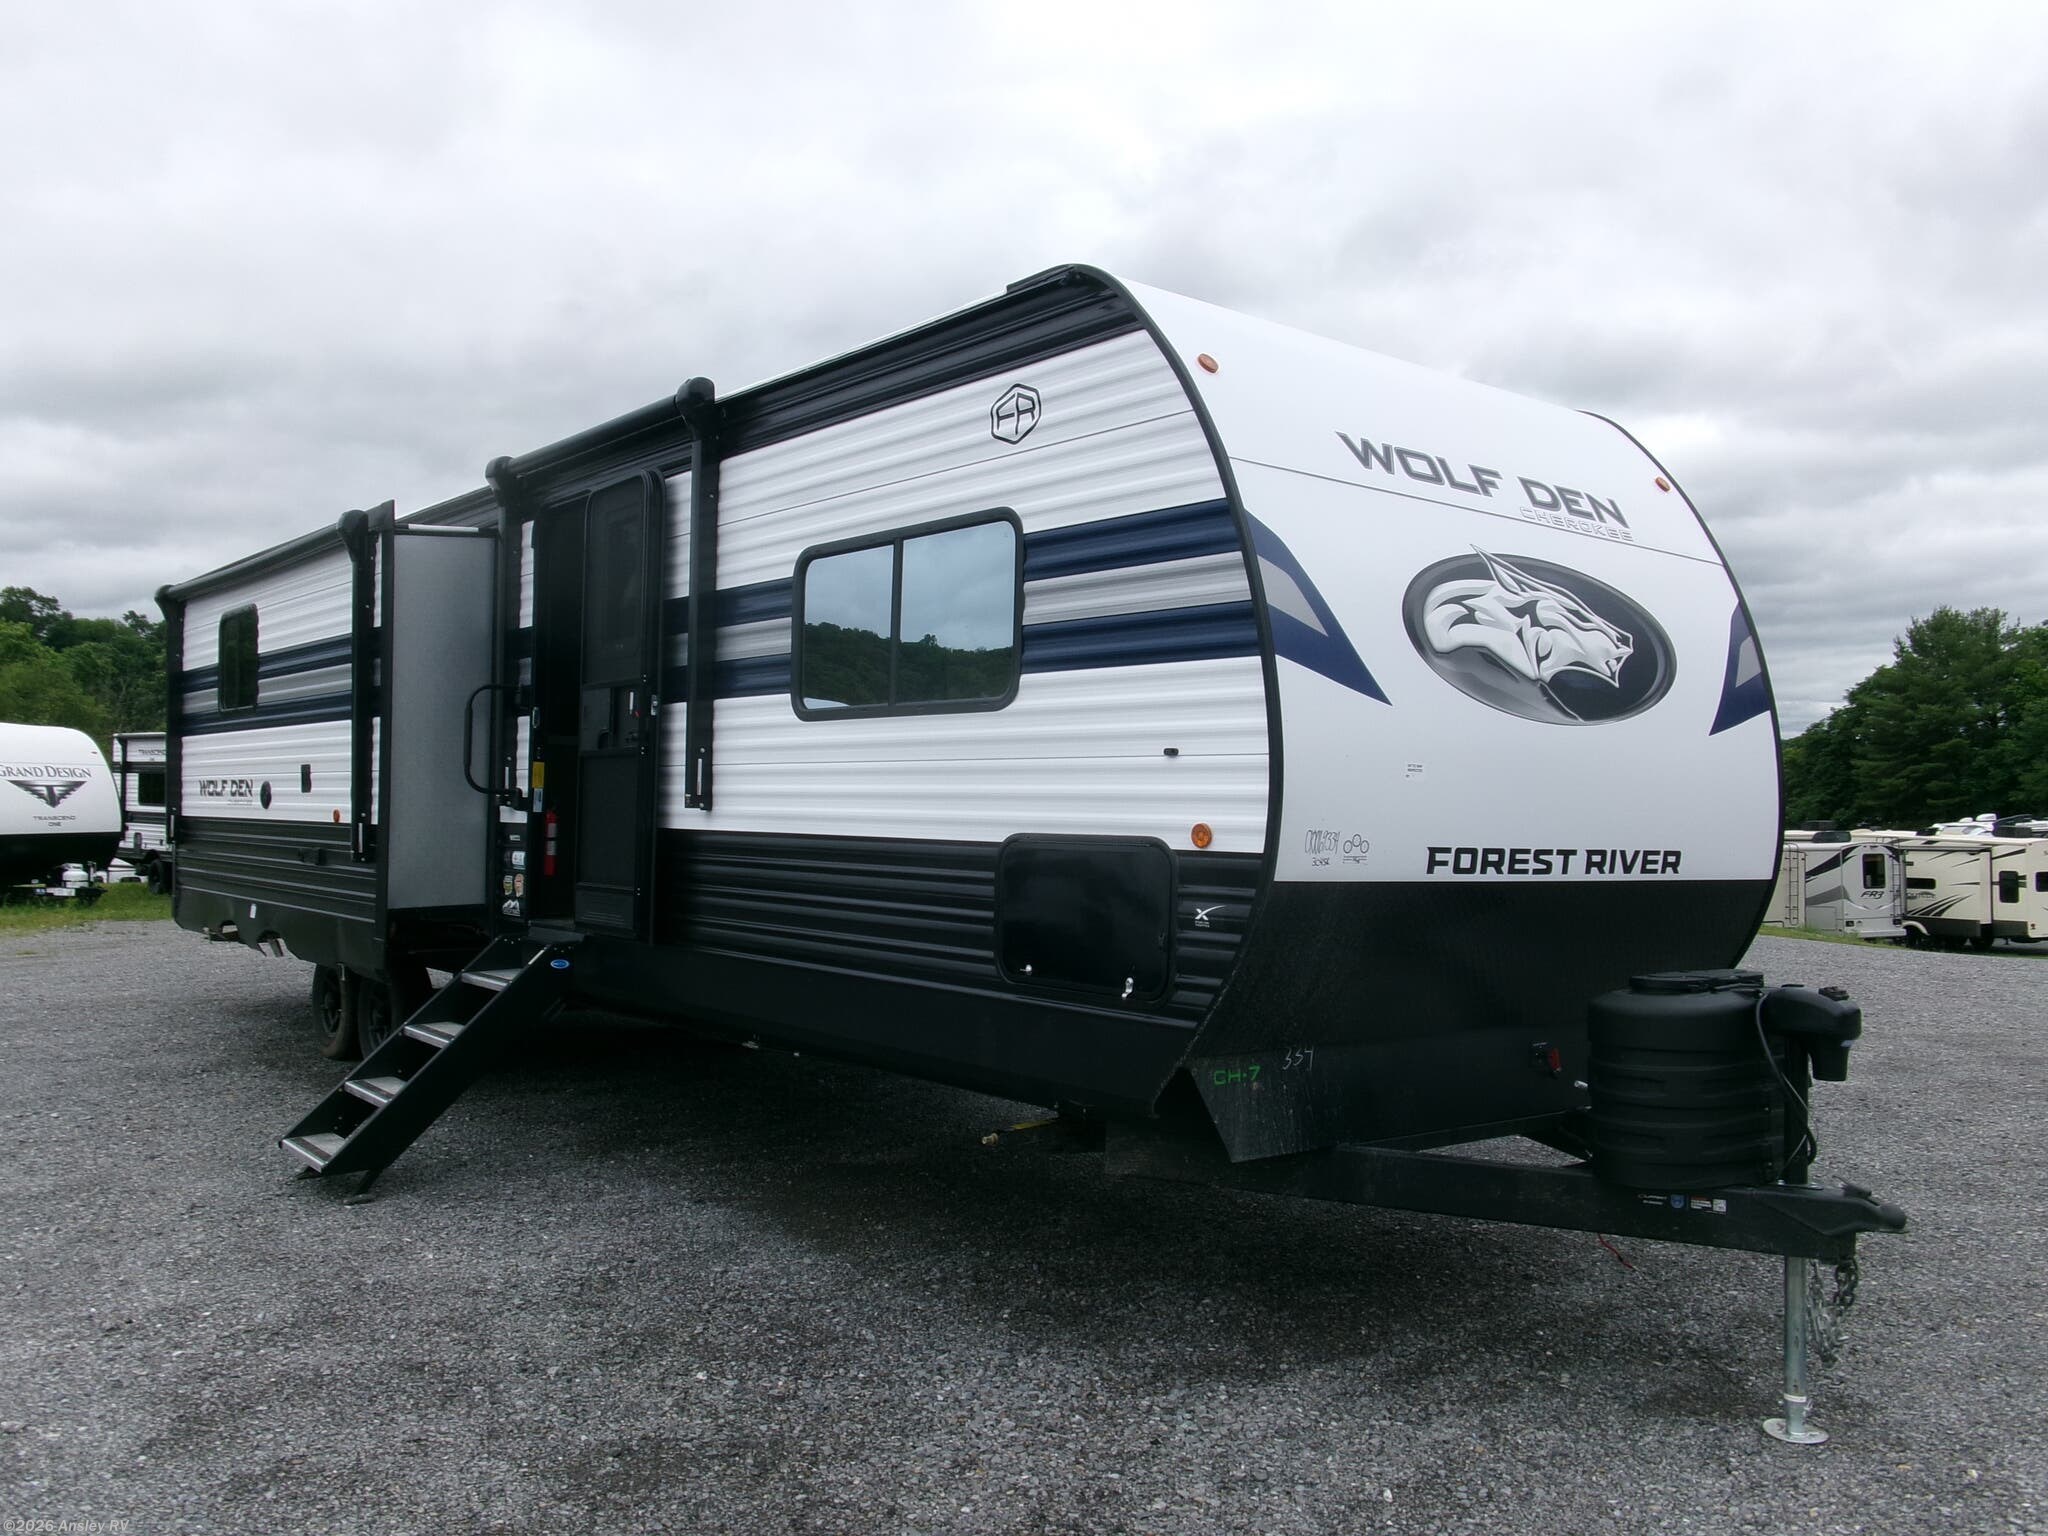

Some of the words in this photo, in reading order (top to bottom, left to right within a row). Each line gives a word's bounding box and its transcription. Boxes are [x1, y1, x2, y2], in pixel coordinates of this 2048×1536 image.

[1335, 431, 1503, 498] WOLF
[1517, 476, 1631, 530] DEN
[1519, 506, 1634, 542] CHEROKEE
[0, 765, 43, 777] GRAND
[44, 766, 92, 778] DESIGN
[199, 779, 228, 797] WOLF
[230, 779, 253, 797] DEN
[1426, 847, 1577, 876] FOREST
[1585, 849, 1682, 875] RIVER
